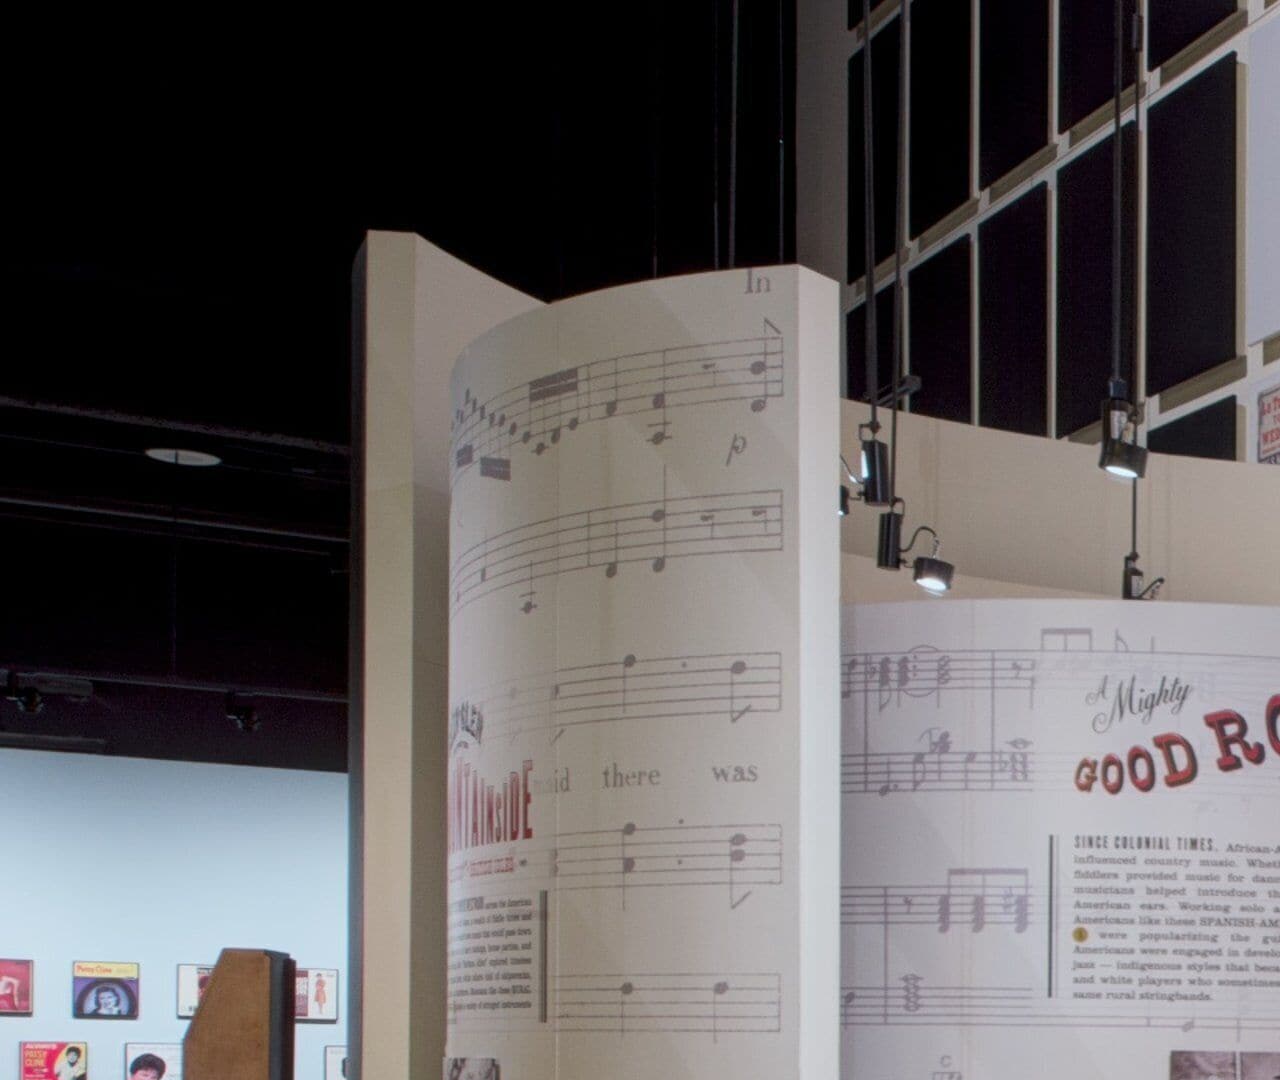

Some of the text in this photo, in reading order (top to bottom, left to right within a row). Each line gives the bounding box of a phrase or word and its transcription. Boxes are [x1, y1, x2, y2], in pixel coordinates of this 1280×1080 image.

[744, 270, 772, 294] In
[1092, 675, 1192, 734] Mighty
[1074, 732, 1198, 795] GOOD
[602, 762, 759, 790] there was
[1074, 835, 1108, 849] SINCE
[1114, 835, 1170, 850] COLONIAL
[1144, 857, 1191, 868] country
[1073, 900, 1232, 914] American Working
[1139, 932, 1219, 943] popularizing
